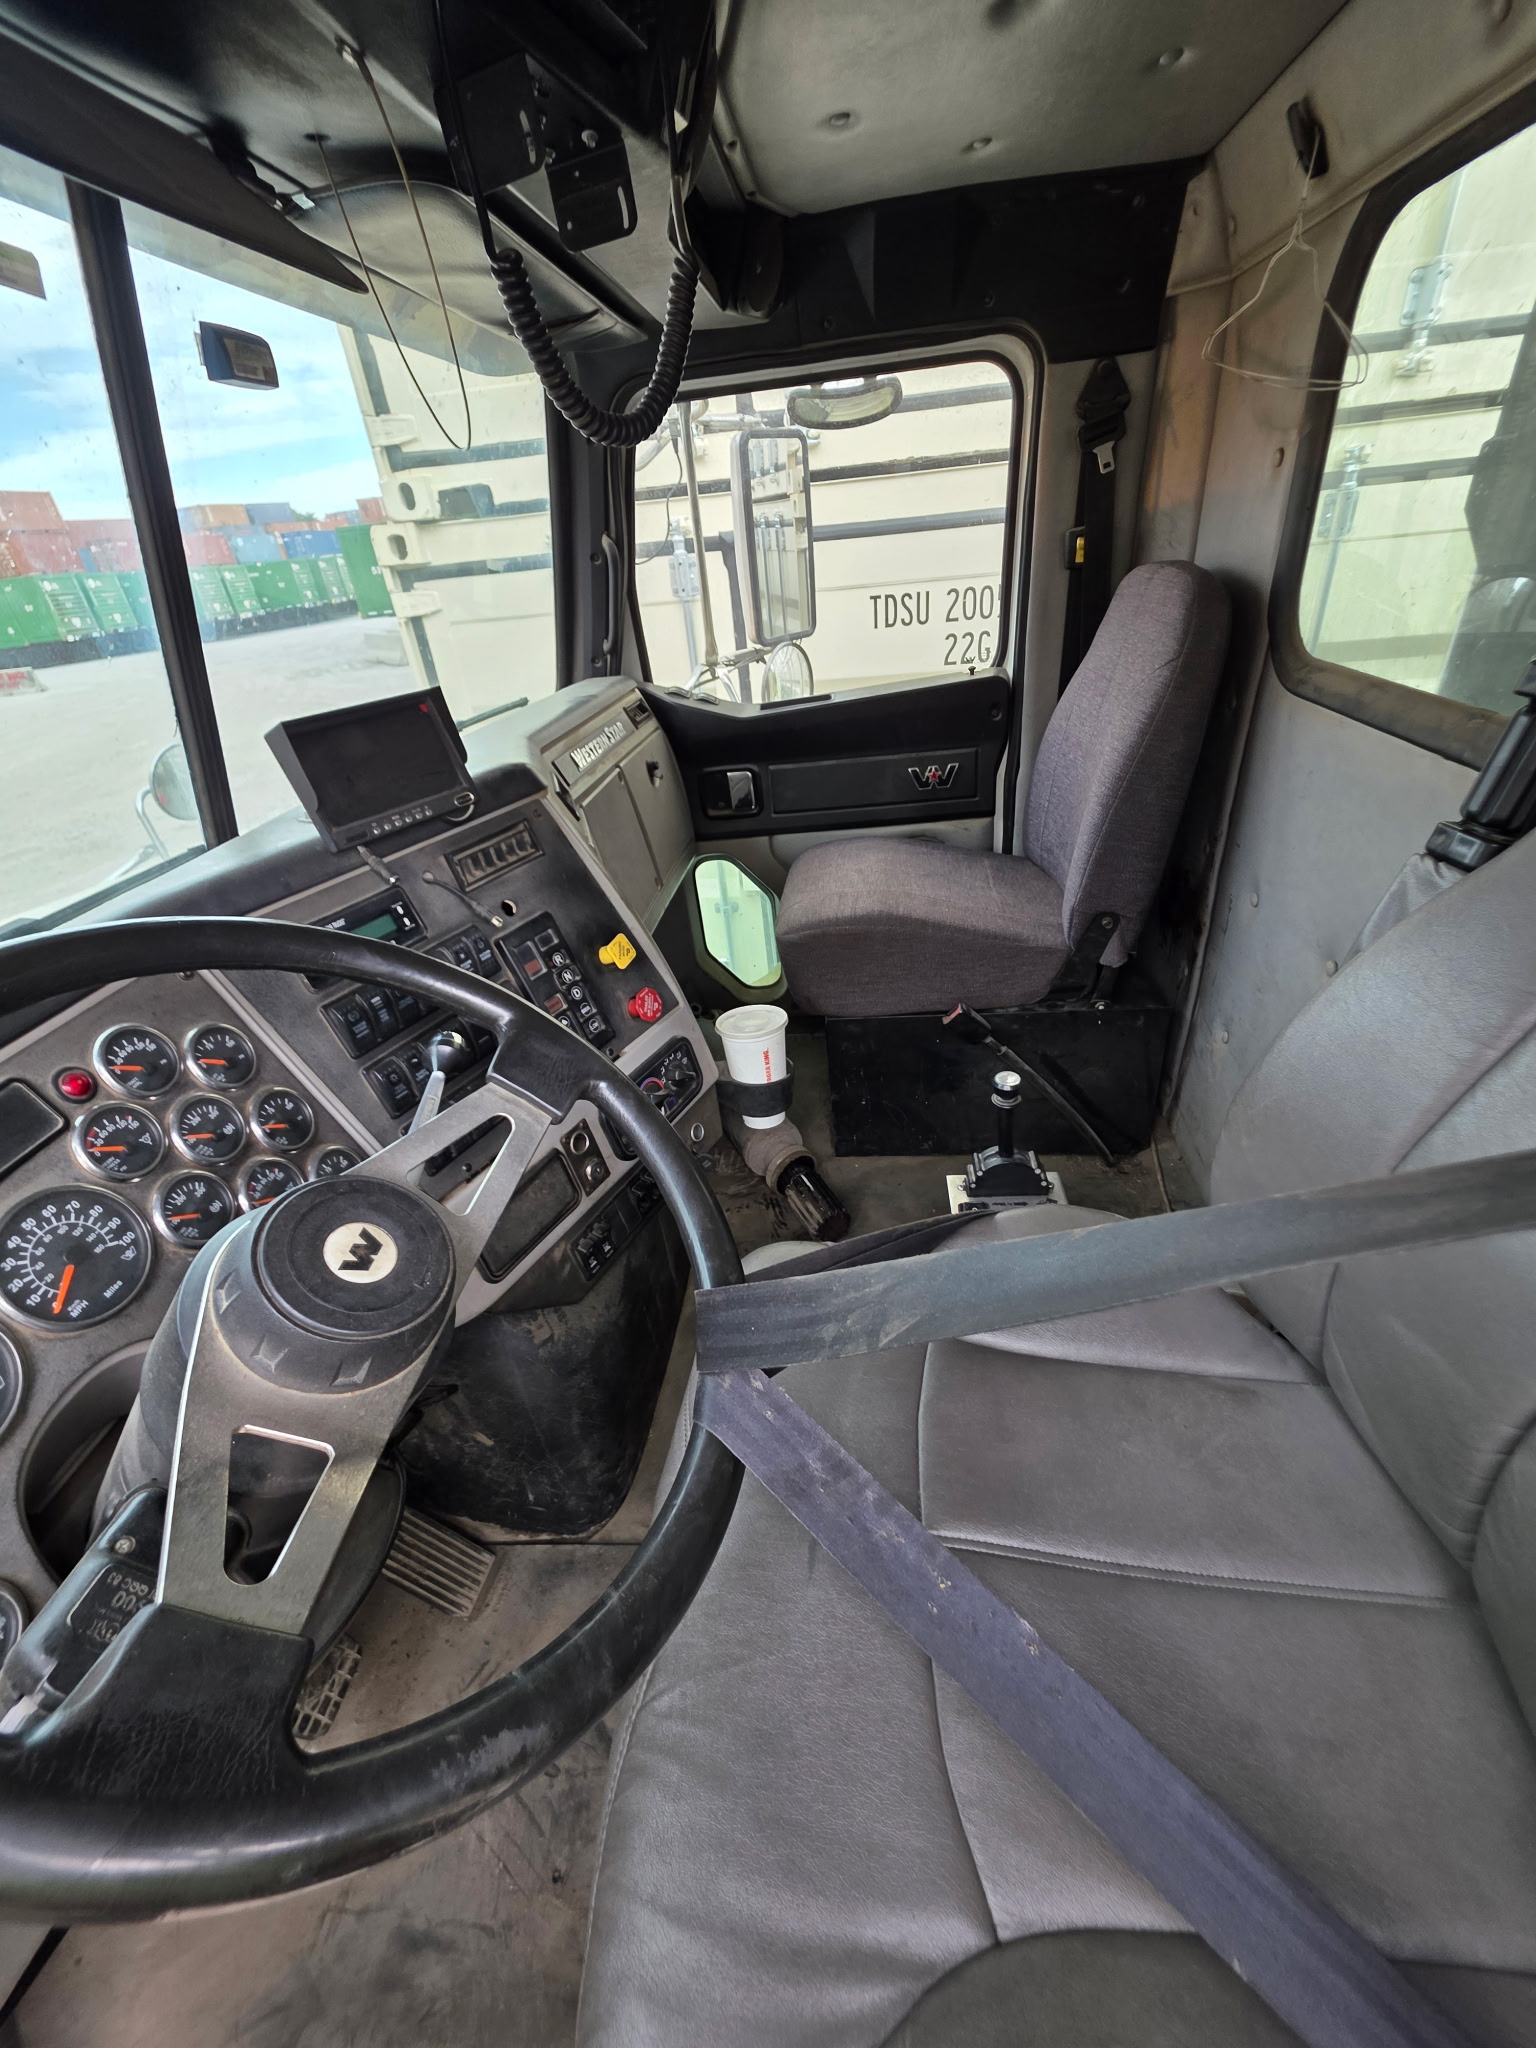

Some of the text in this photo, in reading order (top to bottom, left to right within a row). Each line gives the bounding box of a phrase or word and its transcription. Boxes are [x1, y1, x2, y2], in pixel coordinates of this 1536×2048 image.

[869, 583, 1000, 629] TDSU 200
[943, 630, 992, 666] 22G
[554, 954, 564, 965] R
[563, 971, 573, 982] N
[573, 988, 581, 998] D
[98, 1129, 109, 1139] 60
[106, 1123, 116, 1134] 90
[93, 1138, 104, 1147] 30
[41, 1204, 57, 1217] 60
[65, 1200, 81, 1213] 70
[89, 1204, 104, 1217] 80
[21, 1217, 37, 1231] 50
[107, 1217, 121, 1230] 90
[7, 1235, 22, 1249] 40
[118, 1231, 136, 1246] 100
[0, 1257, 17, 1271] 30
[35, 1261, 45, 1271] 40
[44, 1273, 55, 1282] 20
[7, 1278, 24, 1293] 20
[103, 1280, 123, 1298] Miles
[26, 1294, 41, 1307] 10
[69, 1300, 89, 1318] MPH
